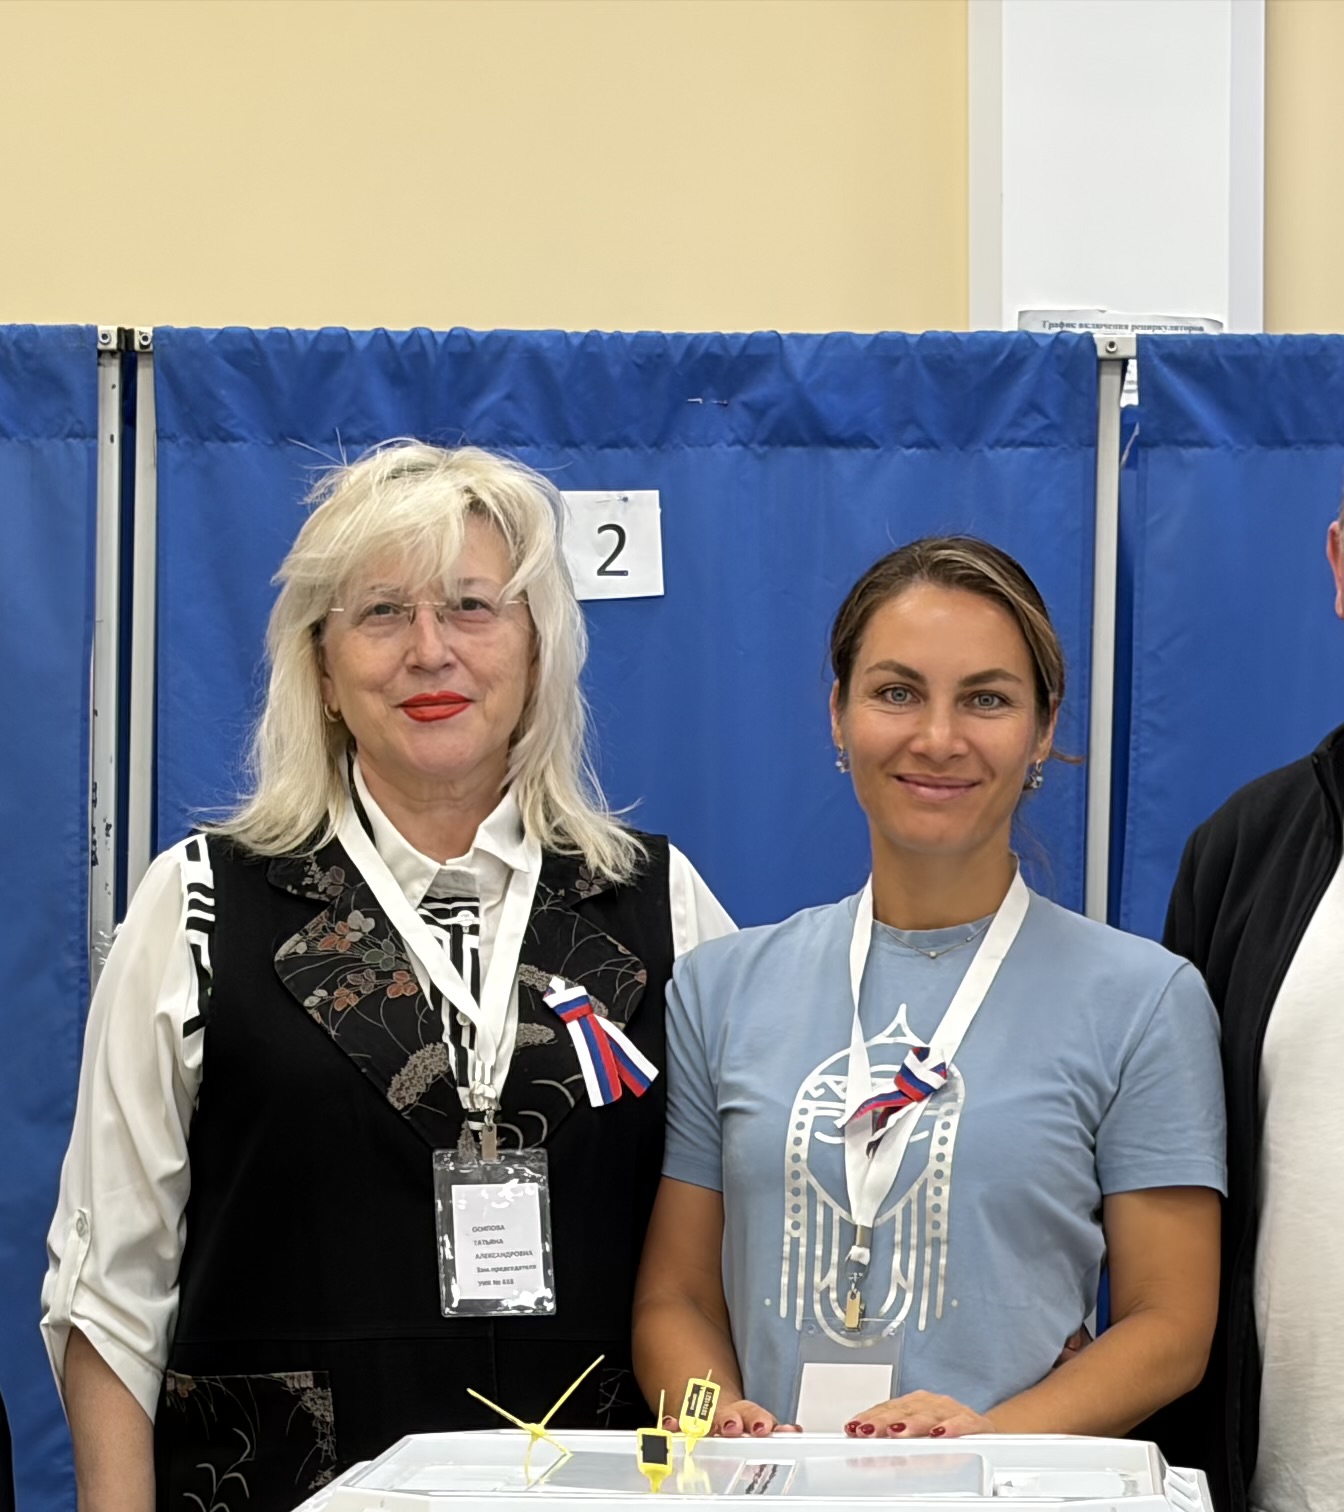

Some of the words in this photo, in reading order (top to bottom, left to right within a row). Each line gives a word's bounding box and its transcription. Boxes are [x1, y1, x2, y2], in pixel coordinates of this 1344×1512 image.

[1042, 319, 1077, 332] График
[1078, 321, 1129, 331] включения
[597, 523, 629, 577] 2
